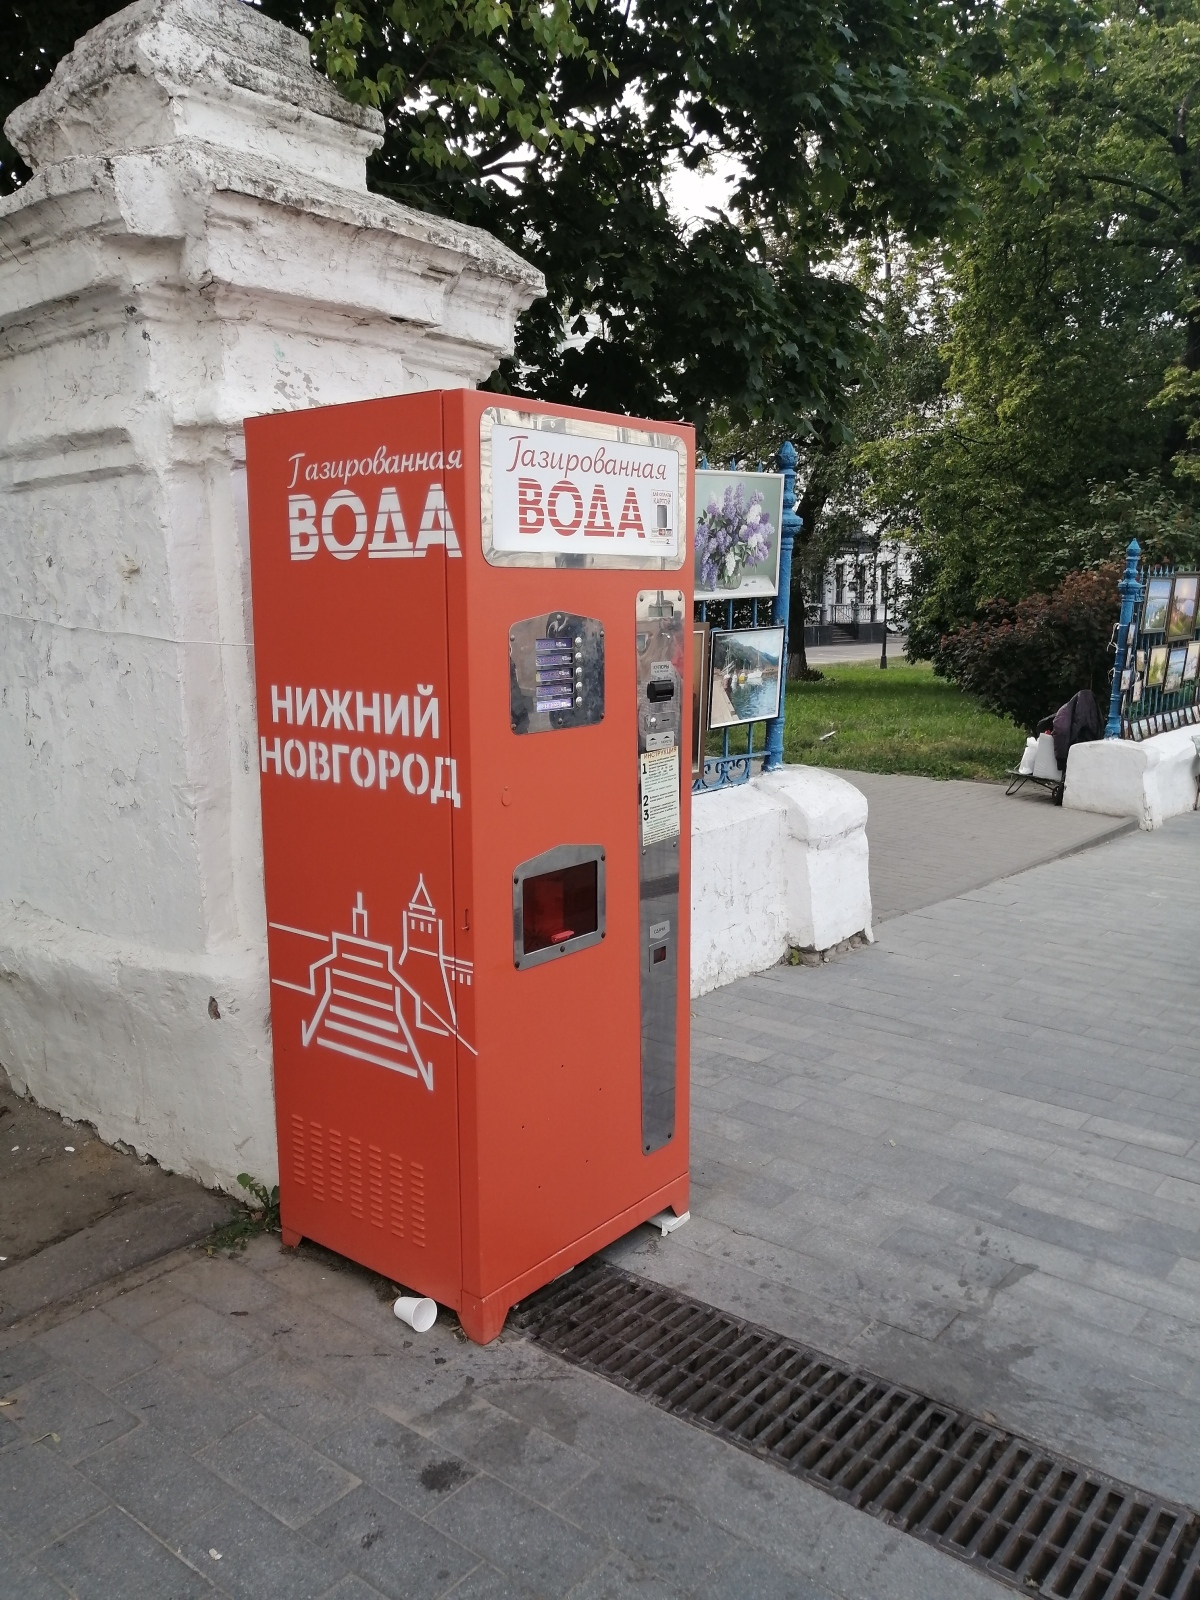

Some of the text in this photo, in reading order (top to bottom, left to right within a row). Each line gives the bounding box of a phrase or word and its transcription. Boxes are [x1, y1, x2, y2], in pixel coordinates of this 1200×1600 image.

[287, 445, 463, 489] Газированная
[506, 436, 667, 481] Газированная
[288, 483, 463, 561] ВОДА
[518, 478, 646, 539] ВОДА
[271, 683, 439, 739] НИЖНИЙ
[260, 736, 461, 808] НОВГОРОД
[642, 763, 647, 774] 1
[644, 747, 676, 759] ИНСТРУКЦИЯ
[643, 795, 648, 807] 2
[644, 809, 649, 821] 3
